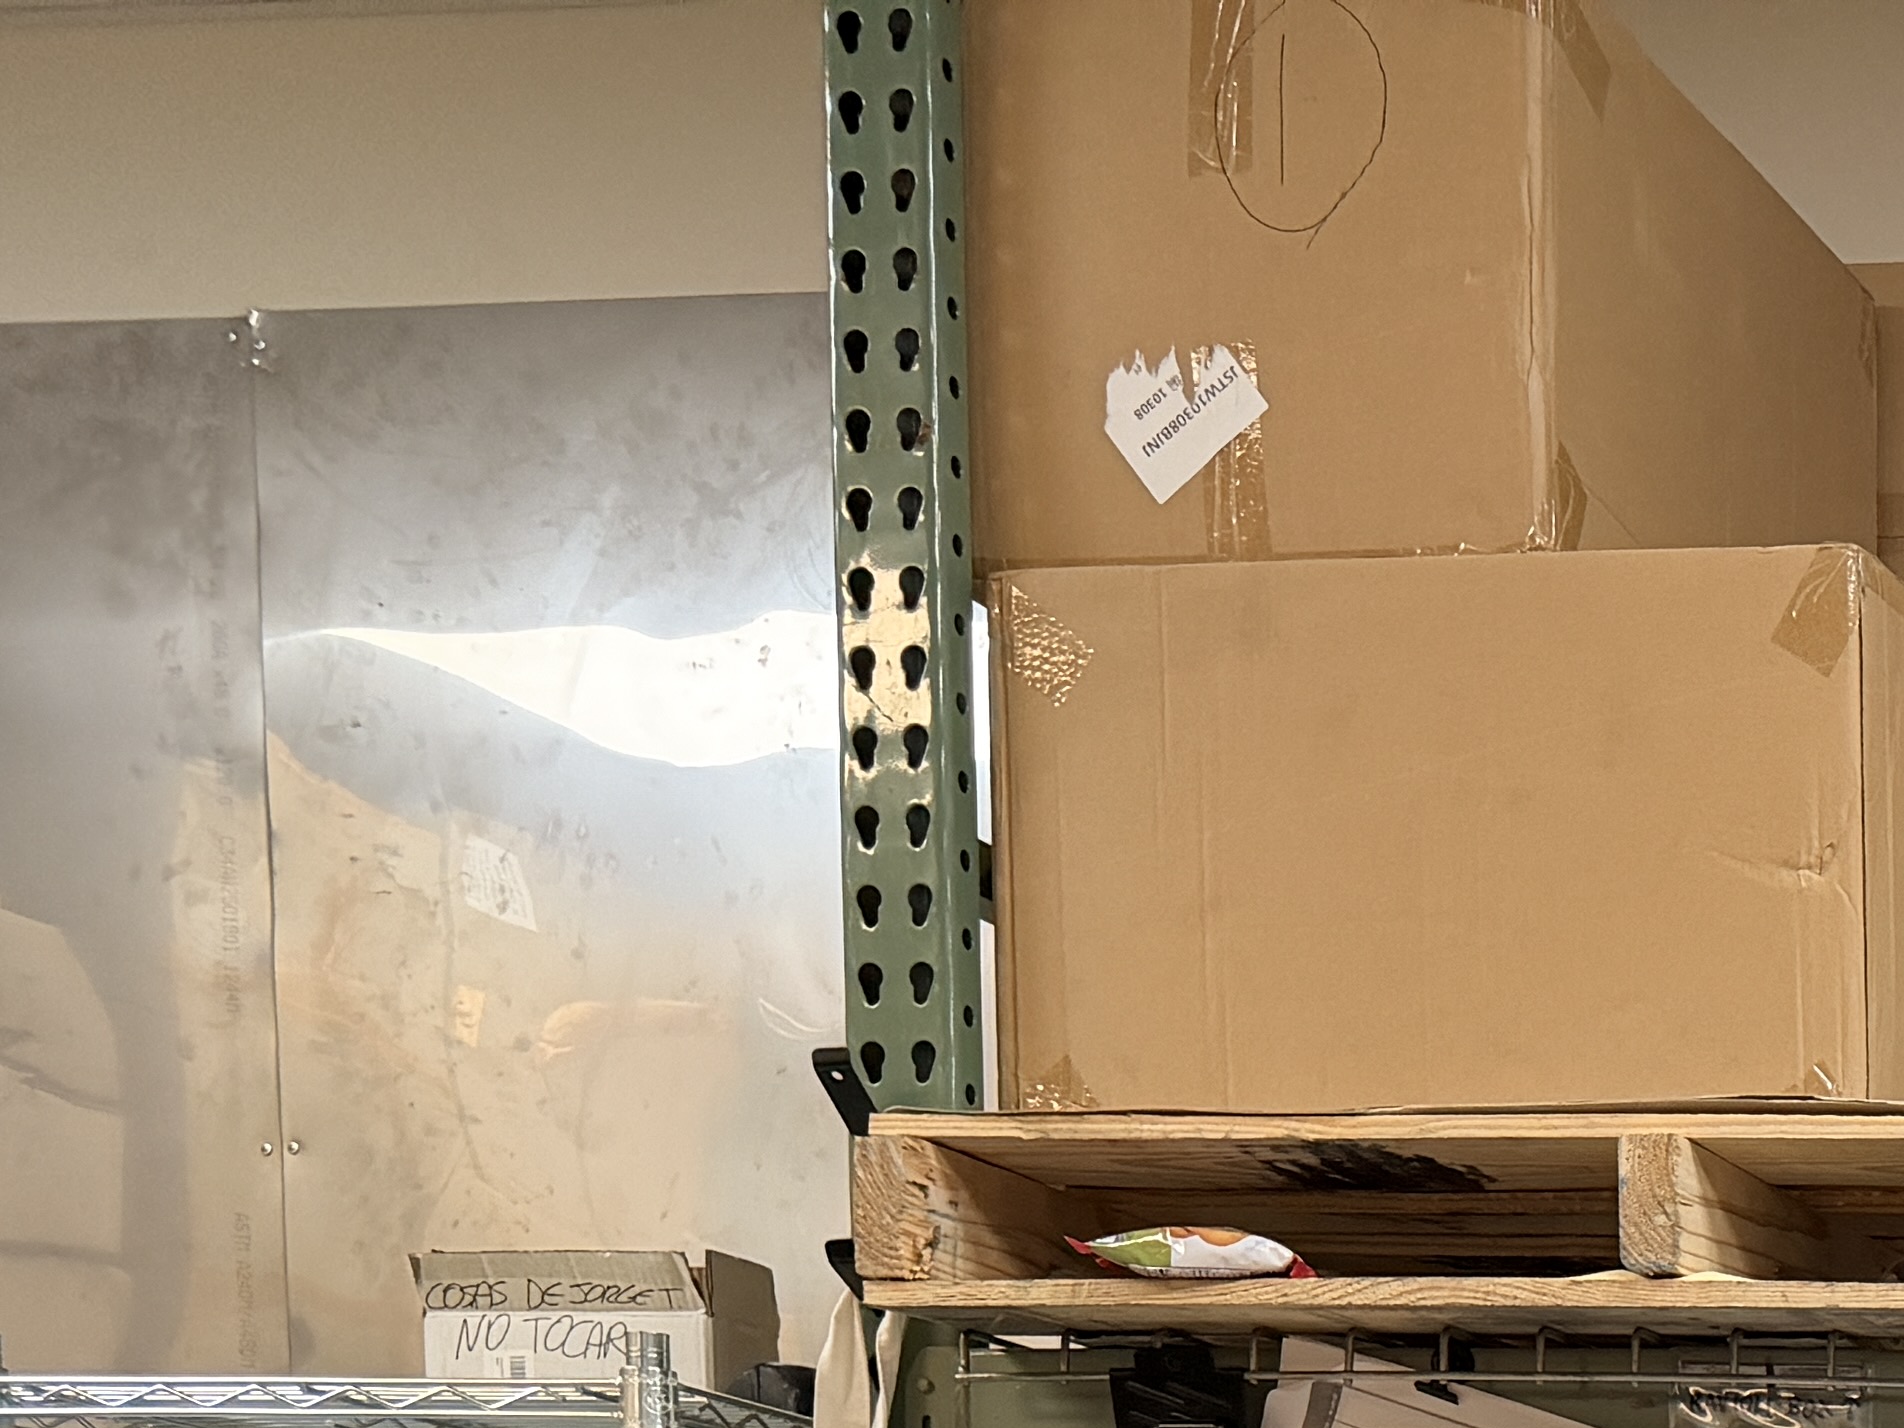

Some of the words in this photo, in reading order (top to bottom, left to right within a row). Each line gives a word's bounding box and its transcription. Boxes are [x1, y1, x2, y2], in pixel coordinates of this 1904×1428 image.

[425, 1279, 508, 1310] COSAS
[526, 1278, 565, 1311] DE
[455, 1313, 511, 1360] NO
[523, 1314, 627, 1360] TOCAR
